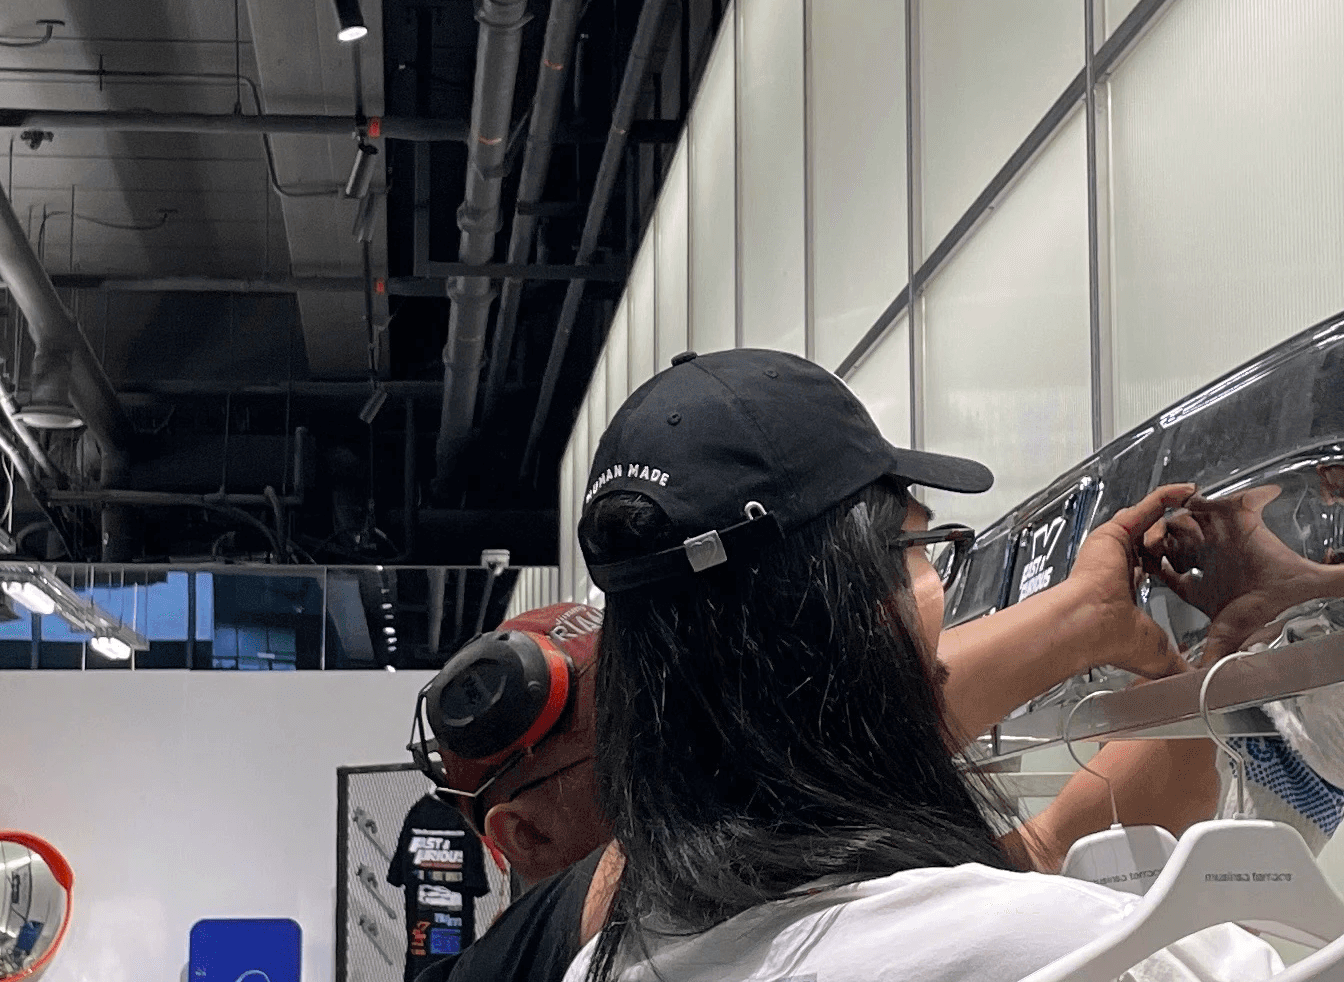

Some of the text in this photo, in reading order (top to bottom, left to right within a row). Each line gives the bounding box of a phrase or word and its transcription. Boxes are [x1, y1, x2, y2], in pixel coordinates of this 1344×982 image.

[627, 463, 670, 487] MADE
[1129, 867, 1163, 880] terrac
[1204, 870, 1292, 882] musinsa terrace
